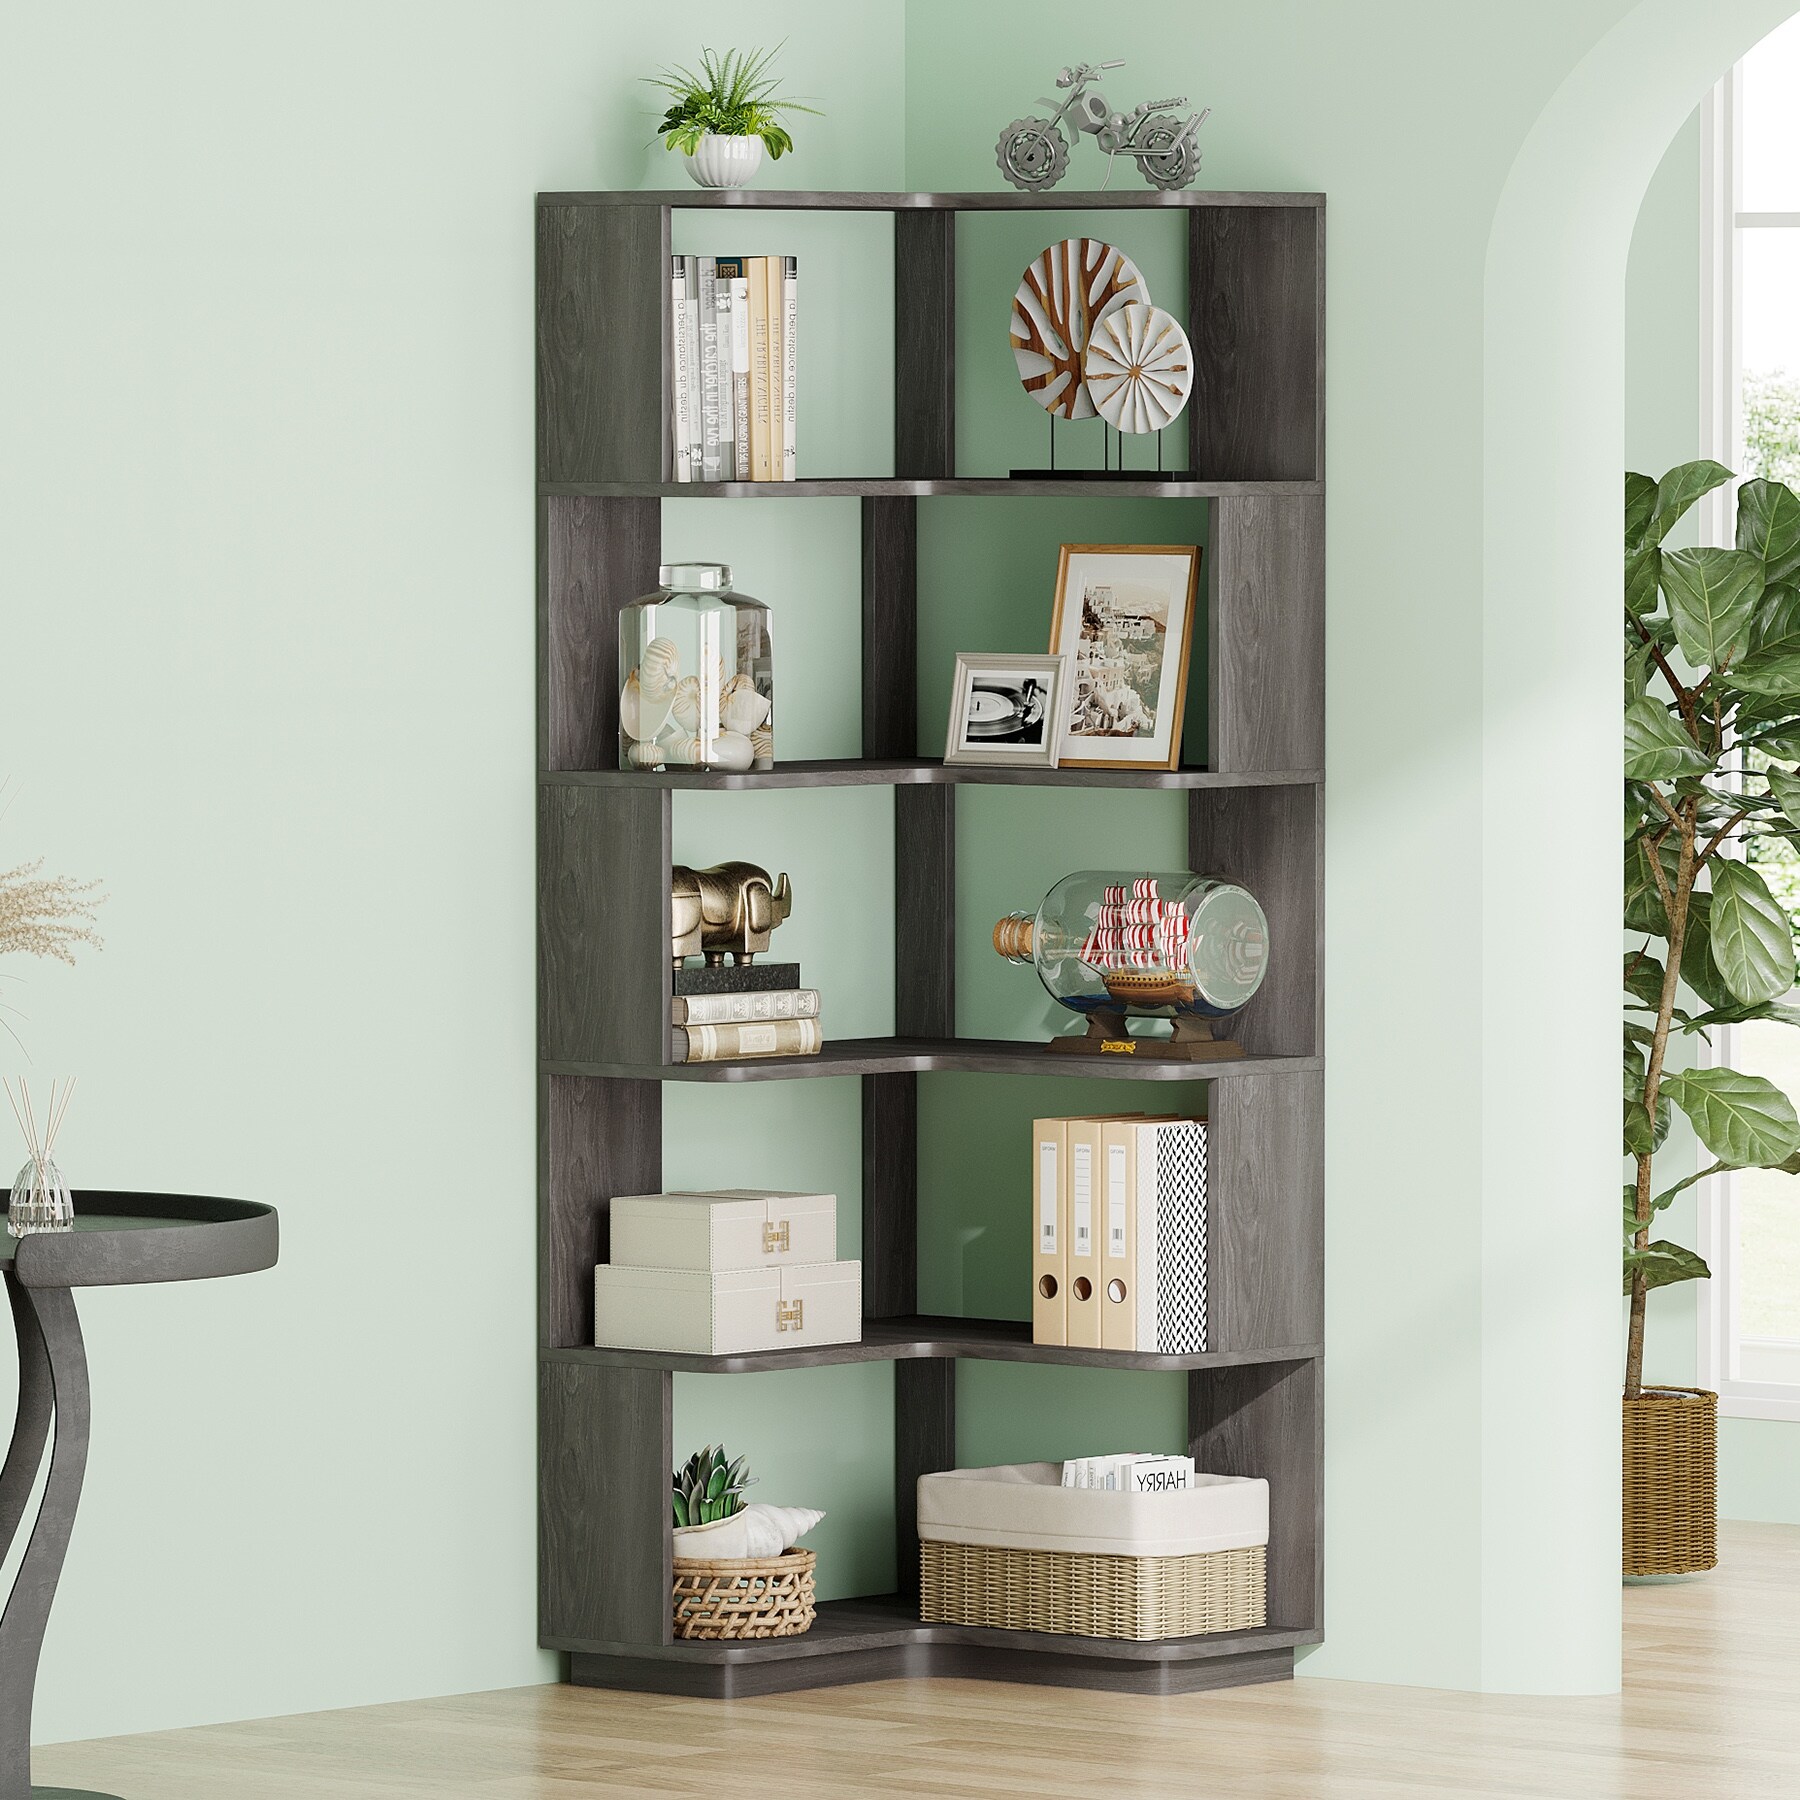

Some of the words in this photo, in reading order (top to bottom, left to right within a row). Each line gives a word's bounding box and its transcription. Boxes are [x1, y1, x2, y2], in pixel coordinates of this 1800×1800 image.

[738, 377, 747, 398] WRITERS
[738, 399, 748, 417] GRANT
[739, 418, 748, 441] ASPIRING
[739, 441, 748, 452] FOR
[740, 452, 749, 464] TIPS
[740, 465, 749, 474] 101
